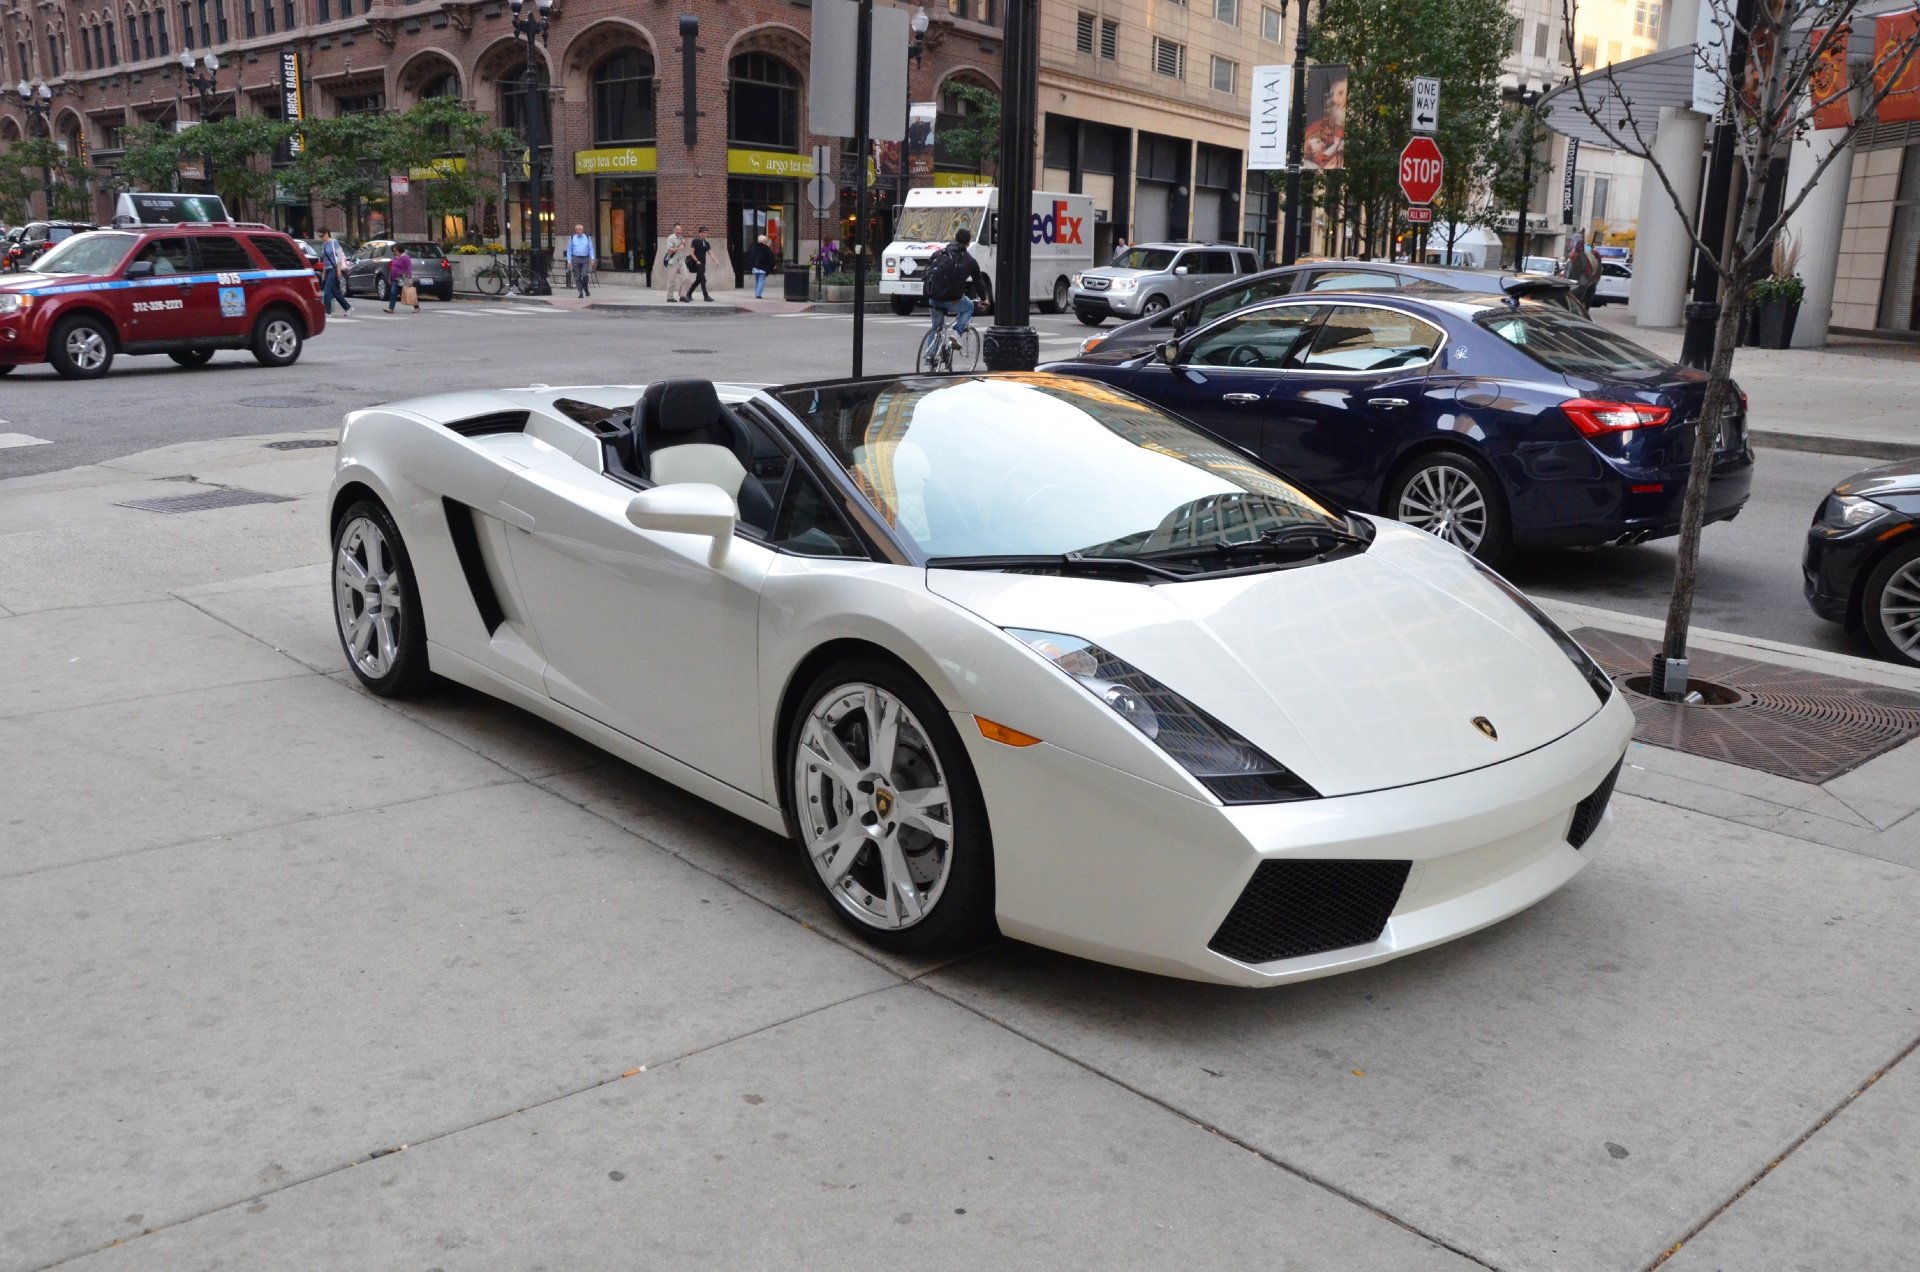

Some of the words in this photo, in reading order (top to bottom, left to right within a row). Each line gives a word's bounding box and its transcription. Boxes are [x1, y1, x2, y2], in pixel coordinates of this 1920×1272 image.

[284, 54, 297, 89] BAGELS
[1417, 82, 1436, 96] ONE
[287, 92, 298, 116] BROS.
[1260, 79, 1280, 149] LUMA
[1416, 97, 1436, 110] WAY
[582, 157, 596, 171] argo
[597, 156, 610, 167] tea
[612, 149, 638, 167] café
[766, 159, 788, 174] argo
[790, 160, 801, 172] tea
[1403, 157, 1440, 183] STOP
[1565, 137, 1577, 186] ORDSTROM
[1564, 187, 1573, 211] rack
[1031, 200, 1083, 244] edEx
[1410, 211, 1418, 219] ALL
[1420, 211, 1429, 220] WAY
